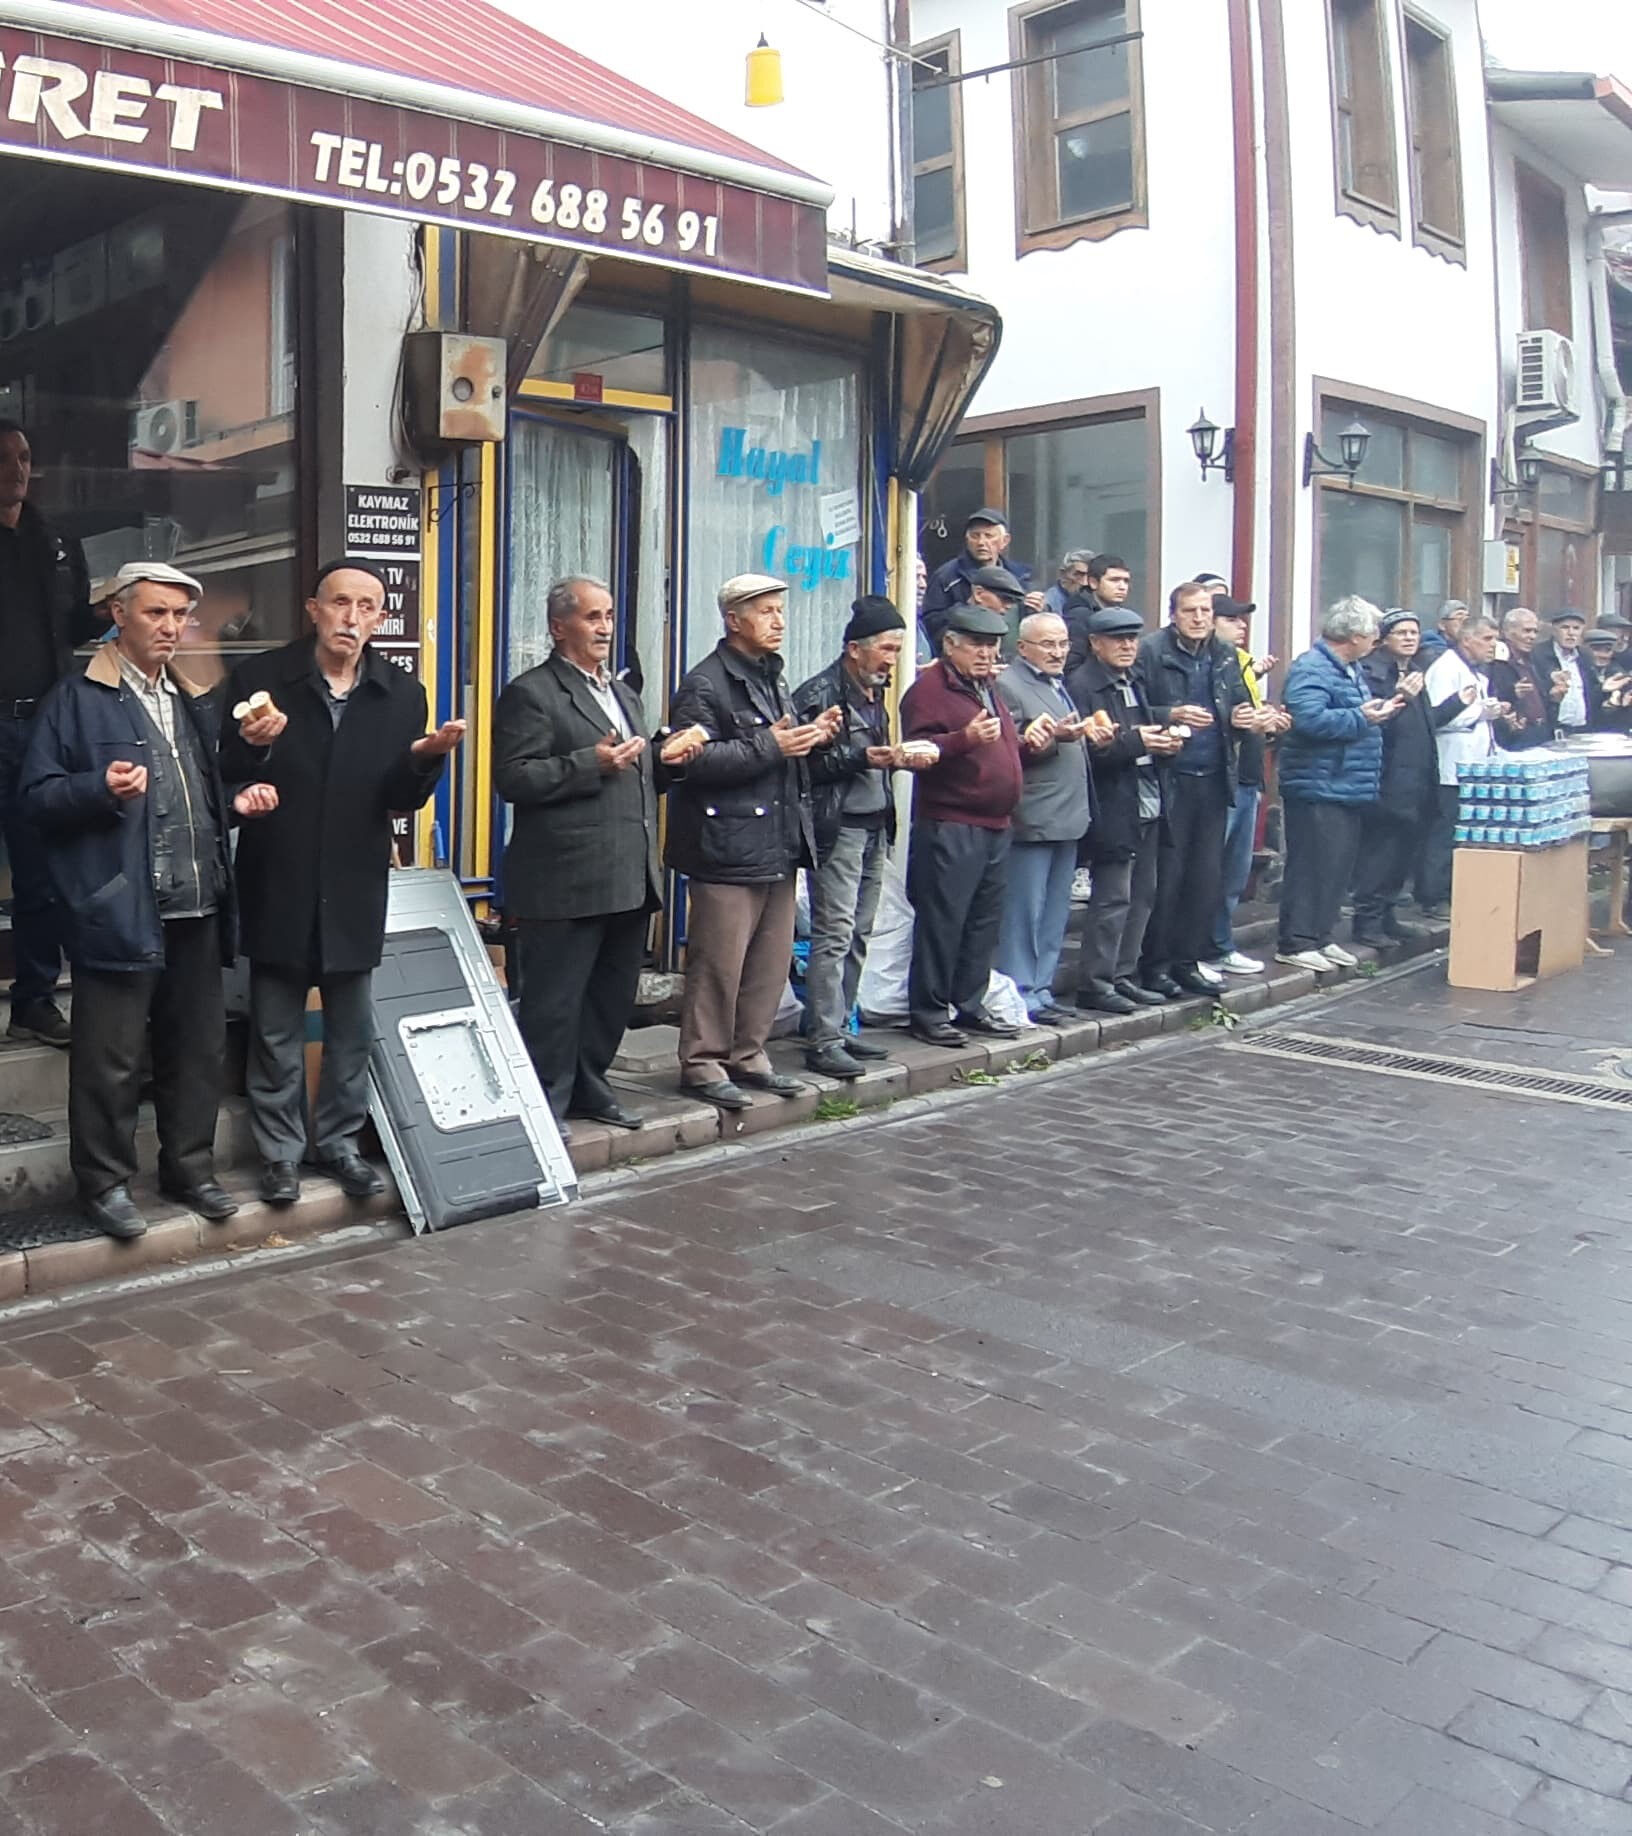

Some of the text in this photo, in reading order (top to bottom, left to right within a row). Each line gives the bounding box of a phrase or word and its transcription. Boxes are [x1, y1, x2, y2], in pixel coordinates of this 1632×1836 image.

[311, 132, 718, 257] TEL:0532 688 56 91
[717, 426, 822, 497] Hayal
[358, 494, 409, 511] KAYMAZ
[347, 513, 419, 531] ELEKTRONİK
[348, 532, 416, 546] 0532 688 56 91
[387, 567, 404, 585] TV
[388, 593, 404, 611] TV
[372, 614, 405, 636] MİRİ
[391, 817, 409, 835] VE
